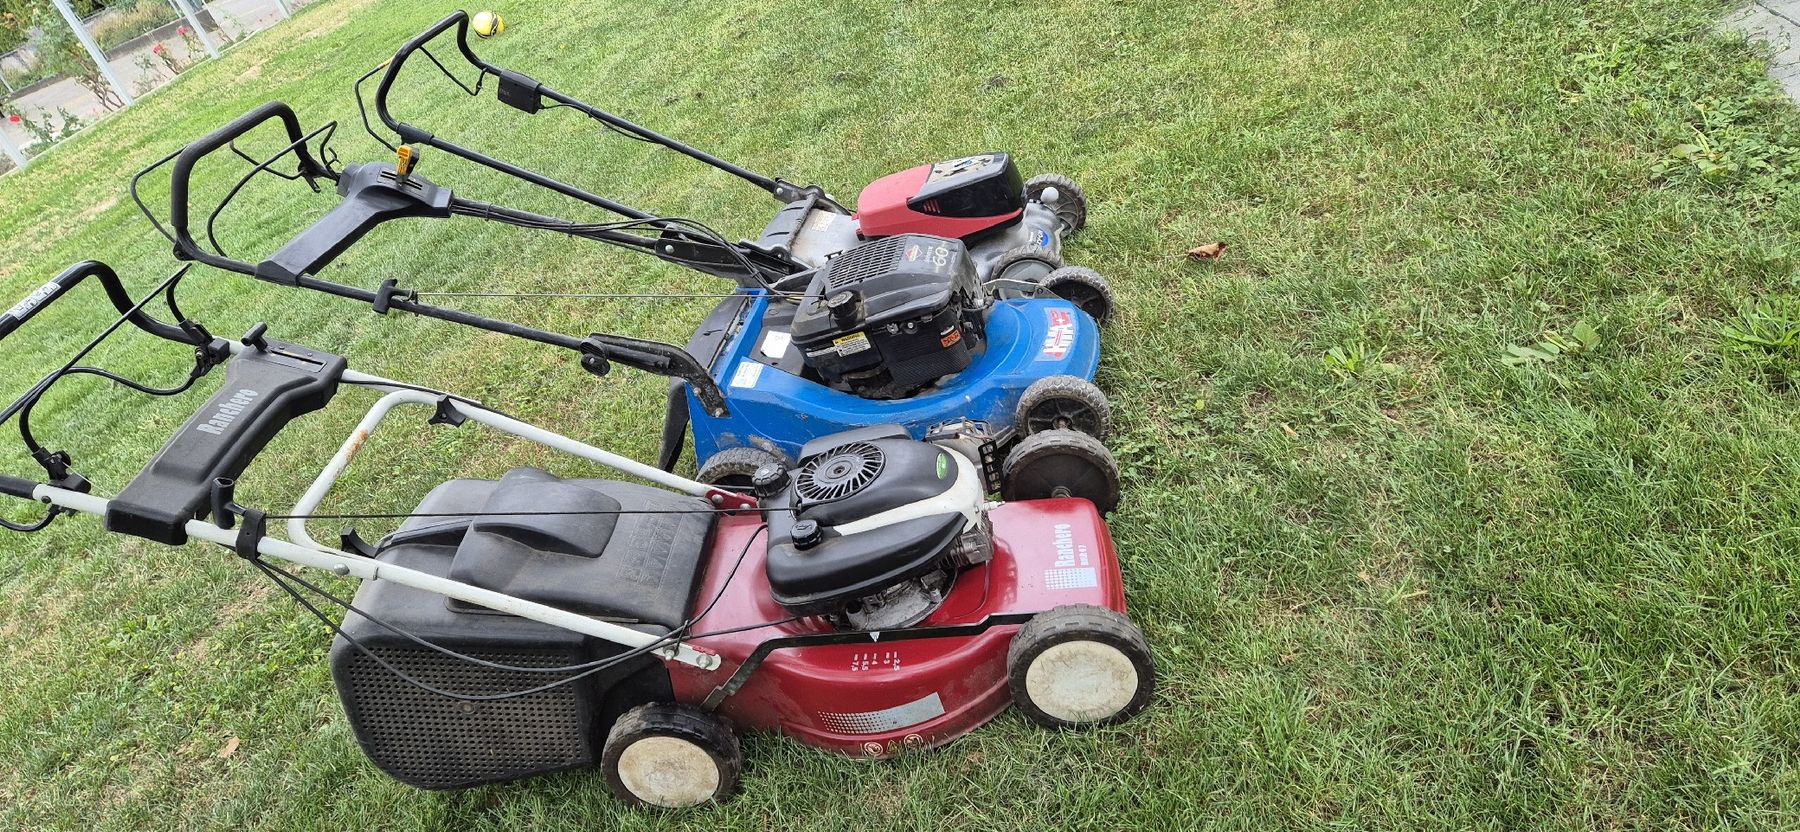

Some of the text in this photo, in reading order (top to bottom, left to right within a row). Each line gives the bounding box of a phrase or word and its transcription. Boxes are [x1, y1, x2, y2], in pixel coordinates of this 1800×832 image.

[932, 246, 949, 266] 60
[196, 389, 258, 435] Ranchero
[1052, 523, 1076, 567] Ranchero
